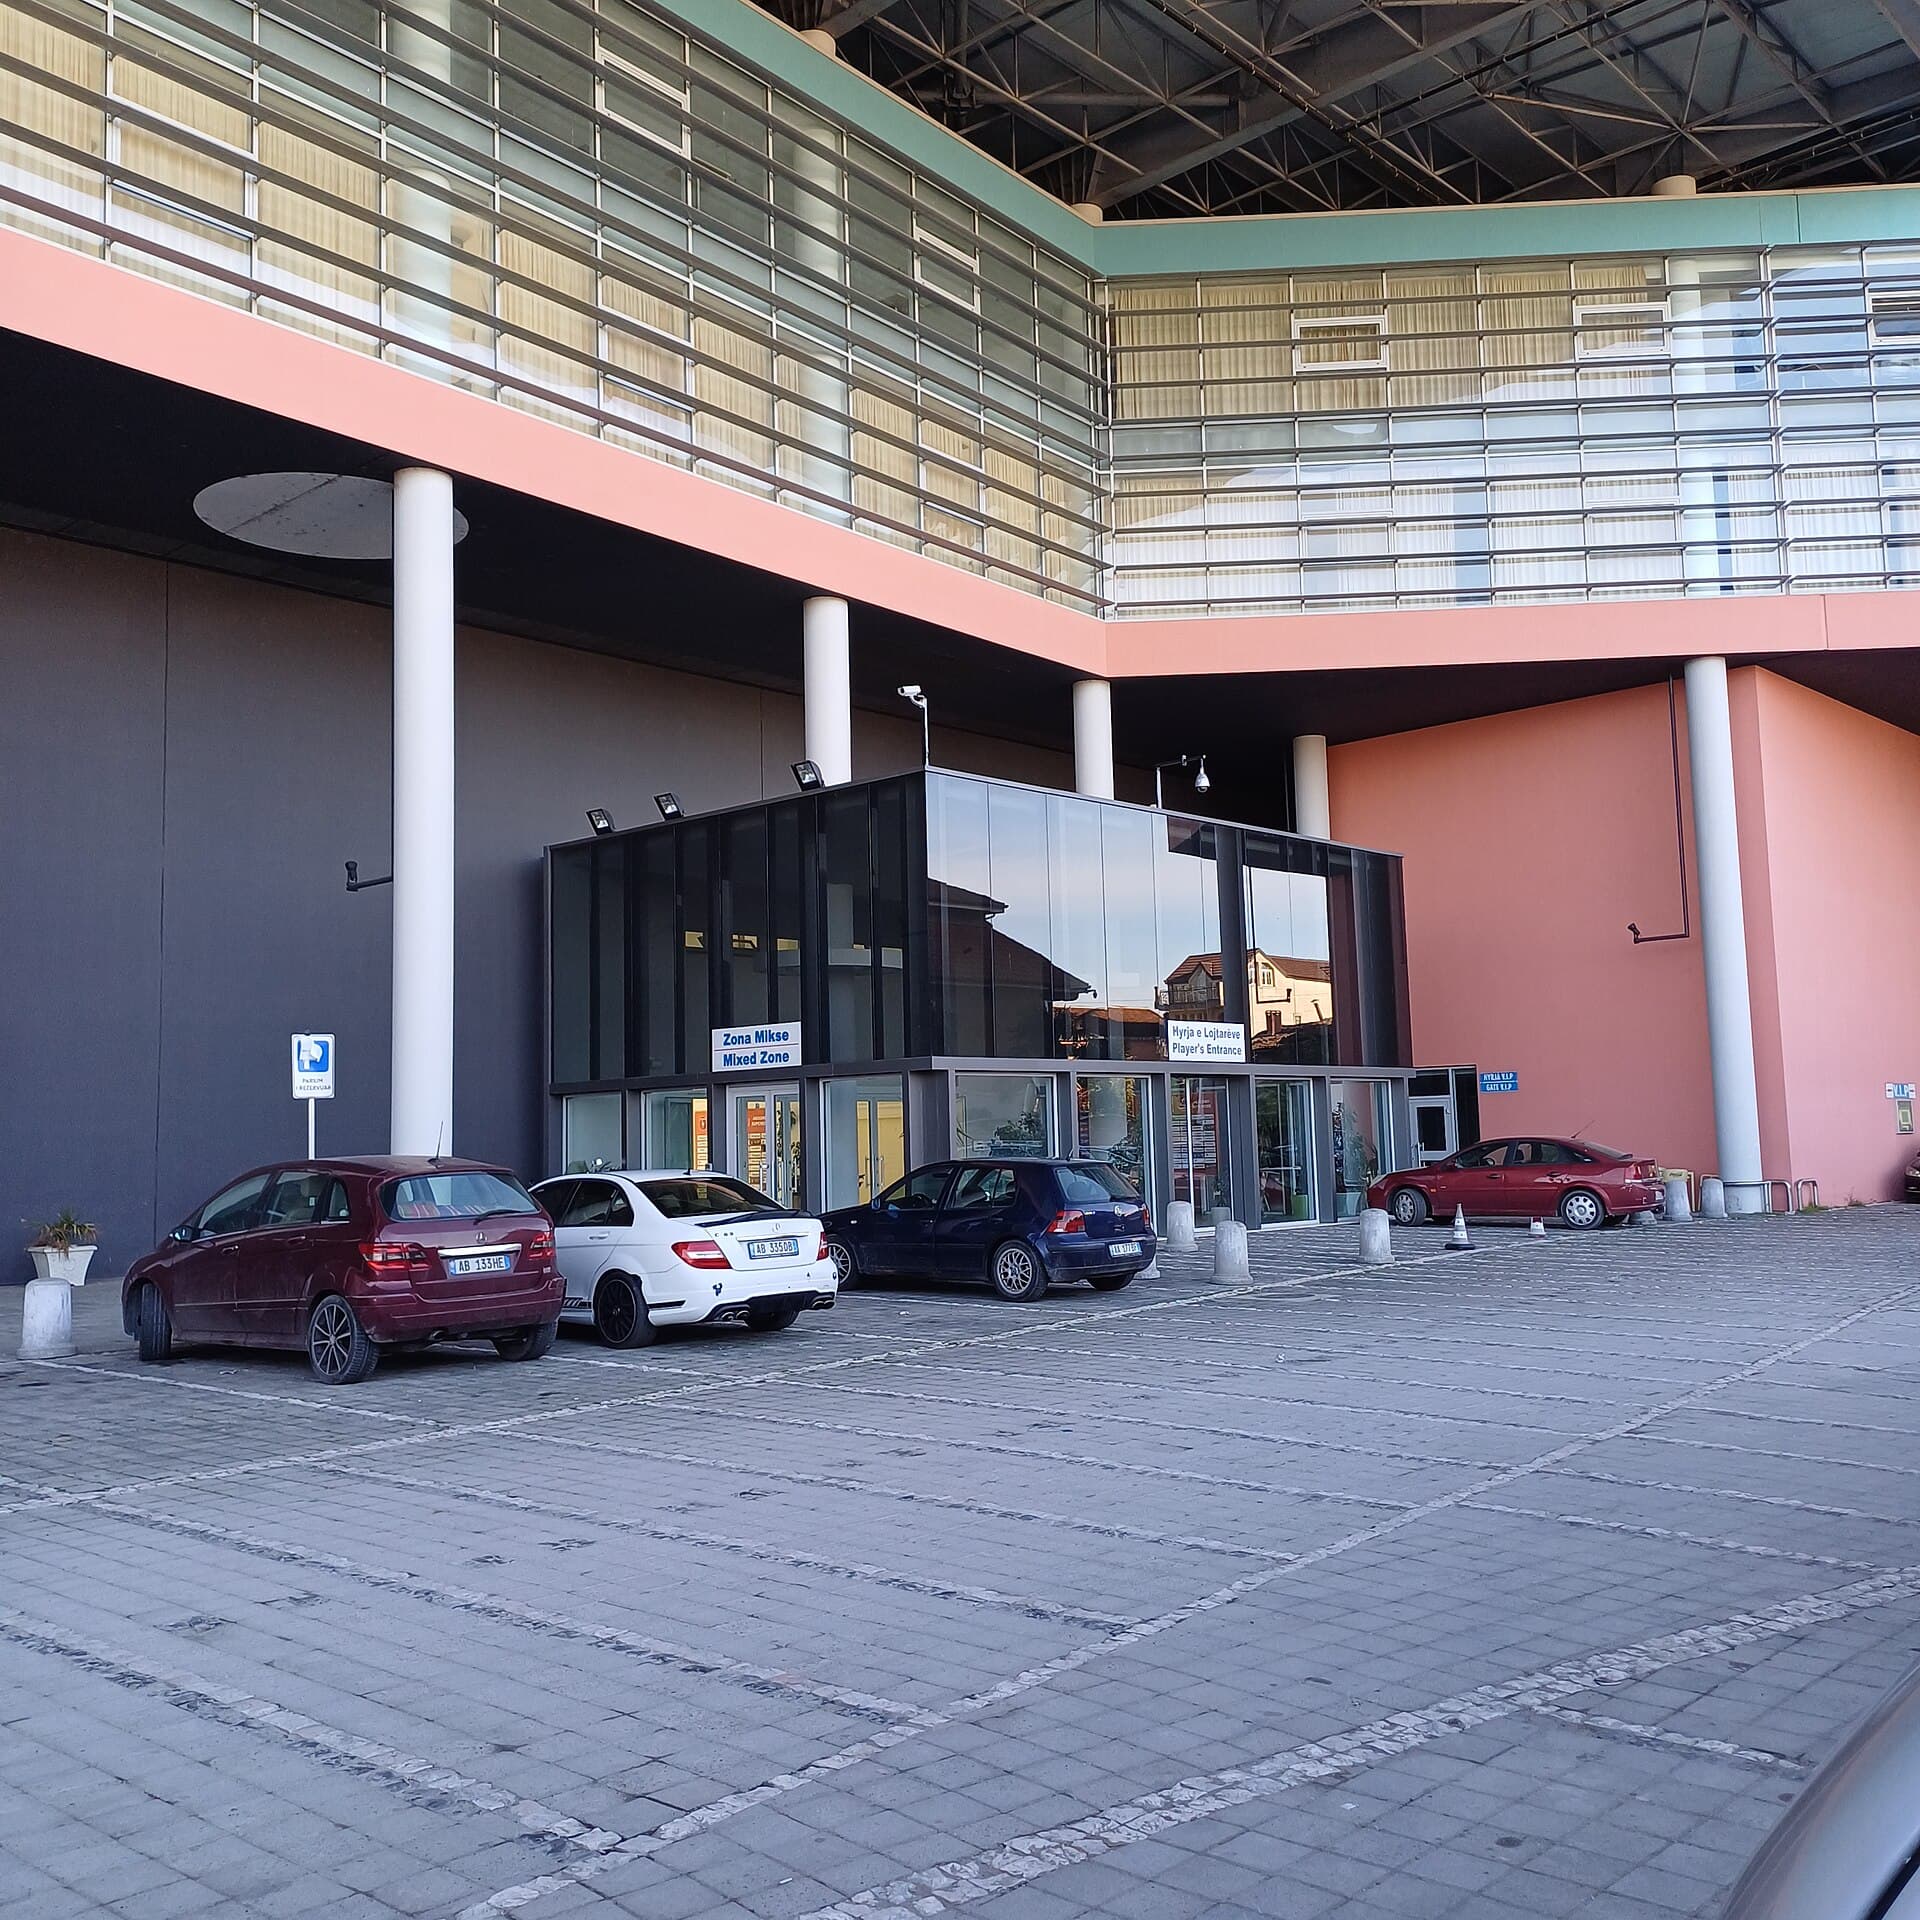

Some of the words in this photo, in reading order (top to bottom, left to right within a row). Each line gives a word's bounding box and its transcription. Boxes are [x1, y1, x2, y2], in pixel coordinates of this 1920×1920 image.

[723, 1033, 751, 1046] Zona
[755, 1029, 789, 1043] Mikse
[1172, 1025, 1195, 1040] Hyrja
[1196, 1029, 1202, 1038] e
[1172, 1042, 1205, 1057] Player's
[1206, 1043, 1242, 1056] Entrance
[723, 1051, 757, 1067] Mixed
[760, 1051, 789, 1065] Zone
[459, 1260, 471, 1272] AB
[475, 1257, 505, 1271] 133HE
